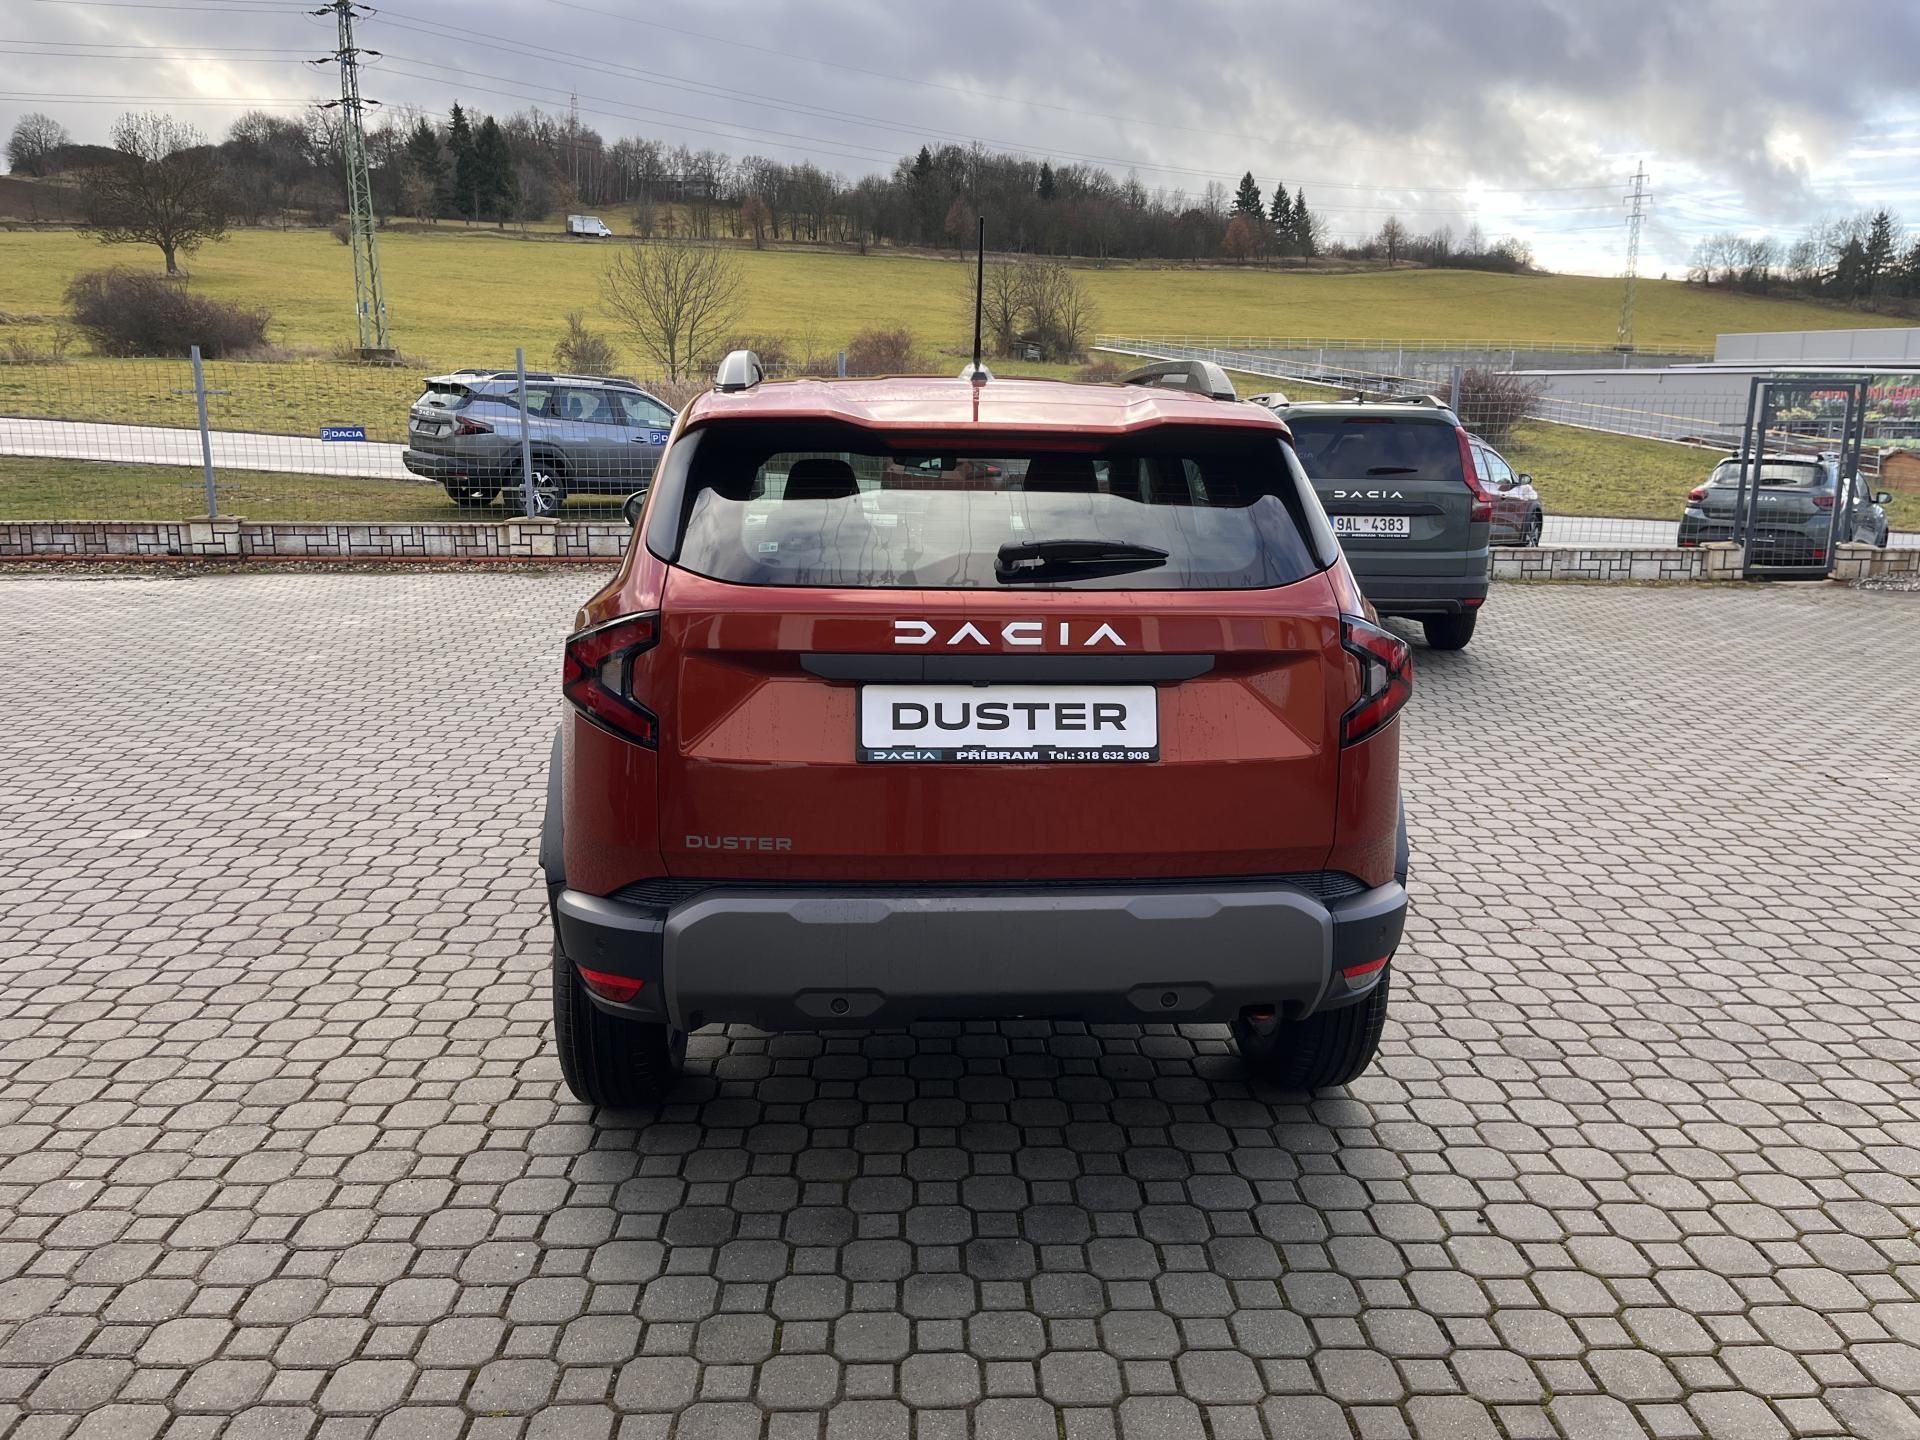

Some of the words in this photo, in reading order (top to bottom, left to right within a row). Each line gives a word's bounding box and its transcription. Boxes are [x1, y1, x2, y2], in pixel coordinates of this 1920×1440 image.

[331, 430, 364, 438] DACIA
[1333, 489, 1404, 499] DACIA
[1336, 517, 1361, 531] 9AL
[1371, 517, 1404, 531] 4383
[894, 620, 1127, 646] DACIA
[892, 702, 1127, 731] DUSTER
[873, 751, 936, 760] DACIA
[956, 749, 1039, 760] PŘÍBRAM
[1048, 751, 1075, 760] Tel.:
[1077, 751, 1100, 760] 318
[1102, 751, 1125, 760] 632
[1127, 751, 1150, 760] 908
[685, 835, 792, 851] DUSTER
